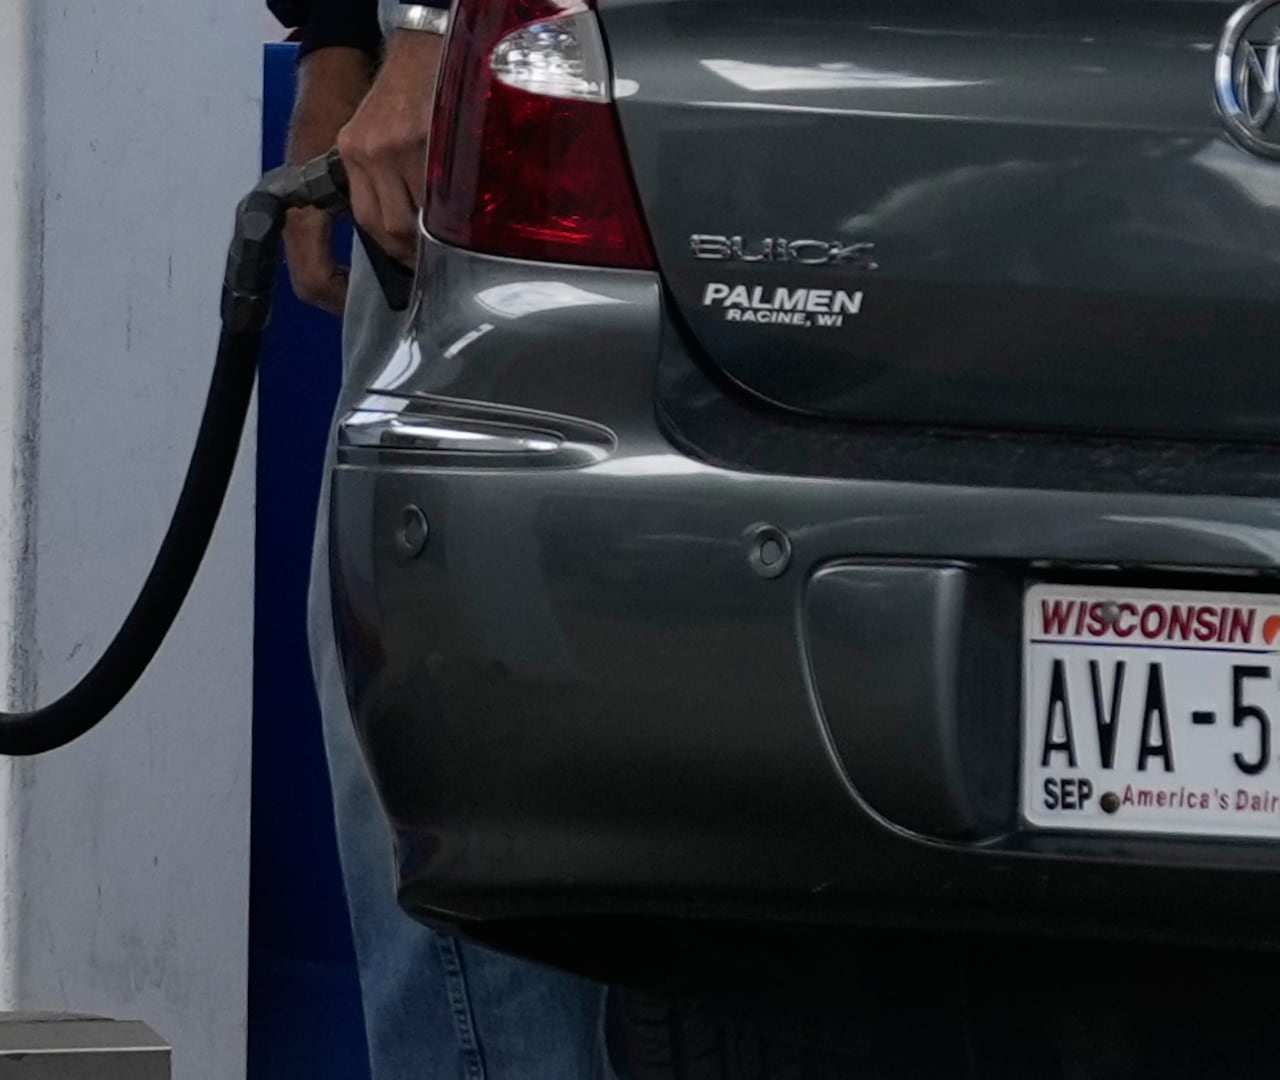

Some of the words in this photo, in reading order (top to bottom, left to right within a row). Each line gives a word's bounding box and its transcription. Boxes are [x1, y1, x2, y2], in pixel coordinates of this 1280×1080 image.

[690, 234, 879, 270] BUICK
[703, 282, 864, 314] PALMEN
[726, 308, 812, 327] RACINE,
[816, 314, 844, 327] WI
[1041, 599, 1258, 644] WISCONSIN
[1042, 659, 1280, 775] AVA-5
[1043, 776, 1094, 811] SEP
[1122, 784, 1230, 810] America's
